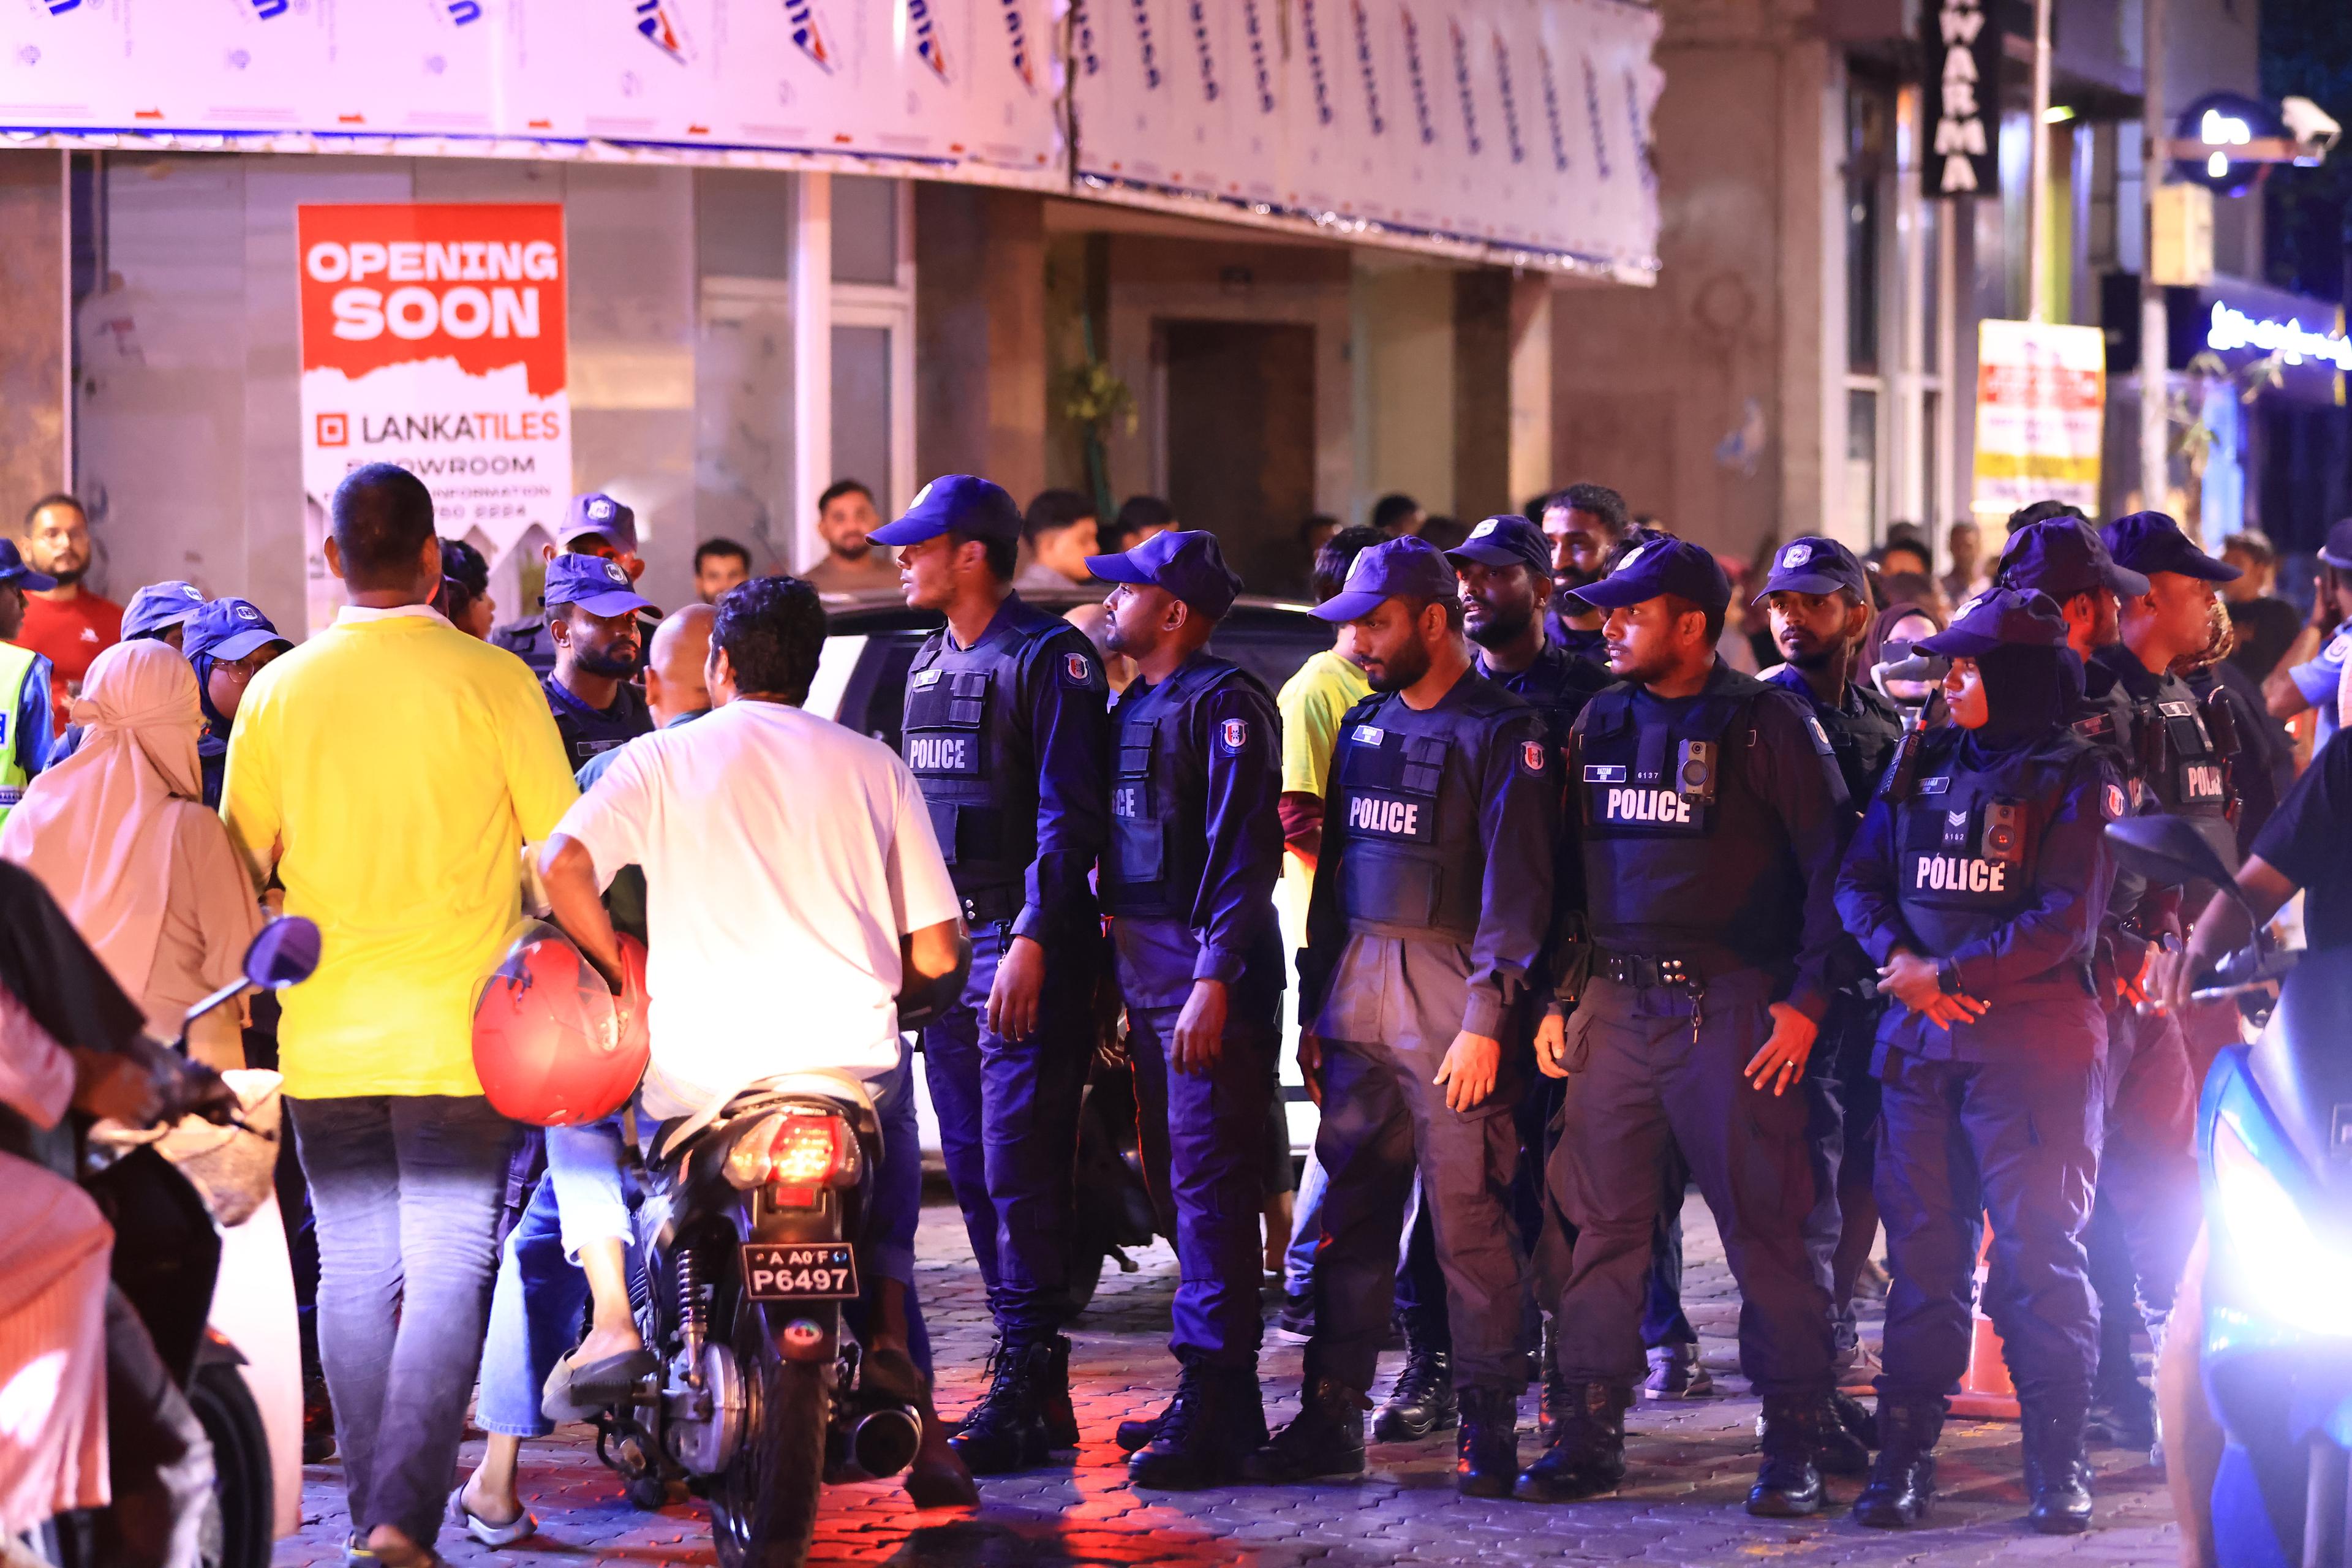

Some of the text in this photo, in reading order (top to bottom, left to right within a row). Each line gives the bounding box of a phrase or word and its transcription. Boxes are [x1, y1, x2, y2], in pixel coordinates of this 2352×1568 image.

[307, 239, 559, 282] OPENING
[331, 286, 540, 341] SOON
[363, 412, 561, 443] LANKATILES
[910, 739, 965, 769] POLICE
[1349, 796, 1418, 834] POLICE
[1607, 789, 1691, 823] POLICE
[1917, 856, 2005, 892] POLICE
[753, 1268, 848, 1292] P6497
